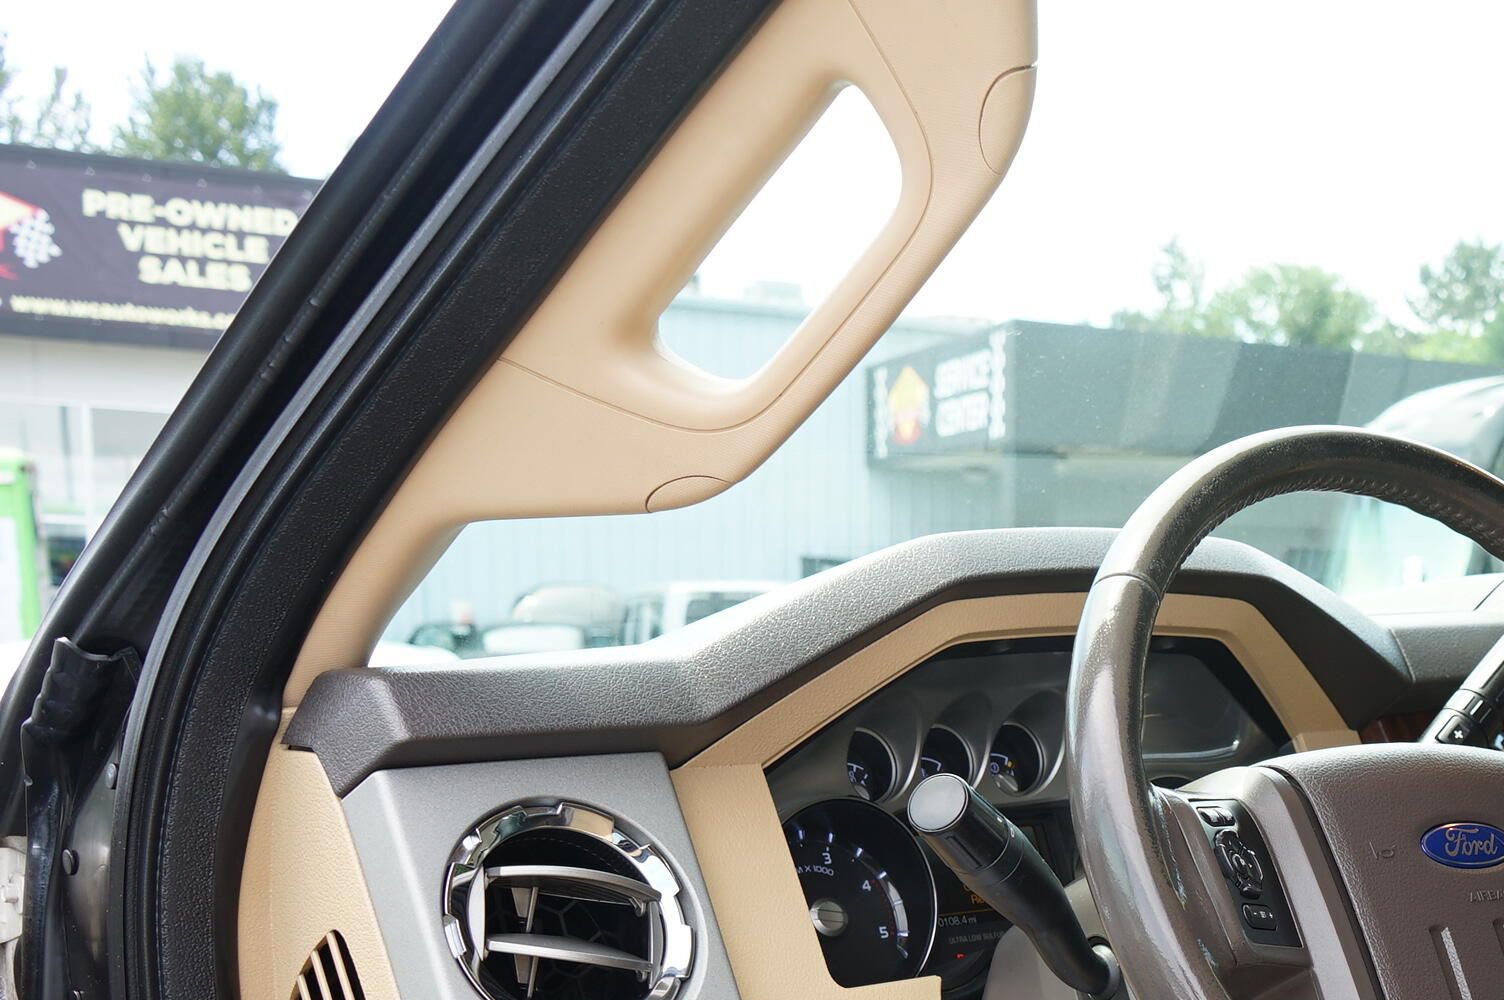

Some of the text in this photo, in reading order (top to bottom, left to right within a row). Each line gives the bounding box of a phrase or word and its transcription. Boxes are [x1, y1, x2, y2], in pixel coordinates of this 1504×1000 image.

[82, 188, 300, 237] PRE-OWNED
[117, 222, 270, 264] VEHICLE
[138, 255, 252, 292] SALES
[1444, 827, 1498, 857] Ford
[822, 852, 833, 865] 3
[862, 880, 872, 892] 4
[879, 926, 889, 939] 5
